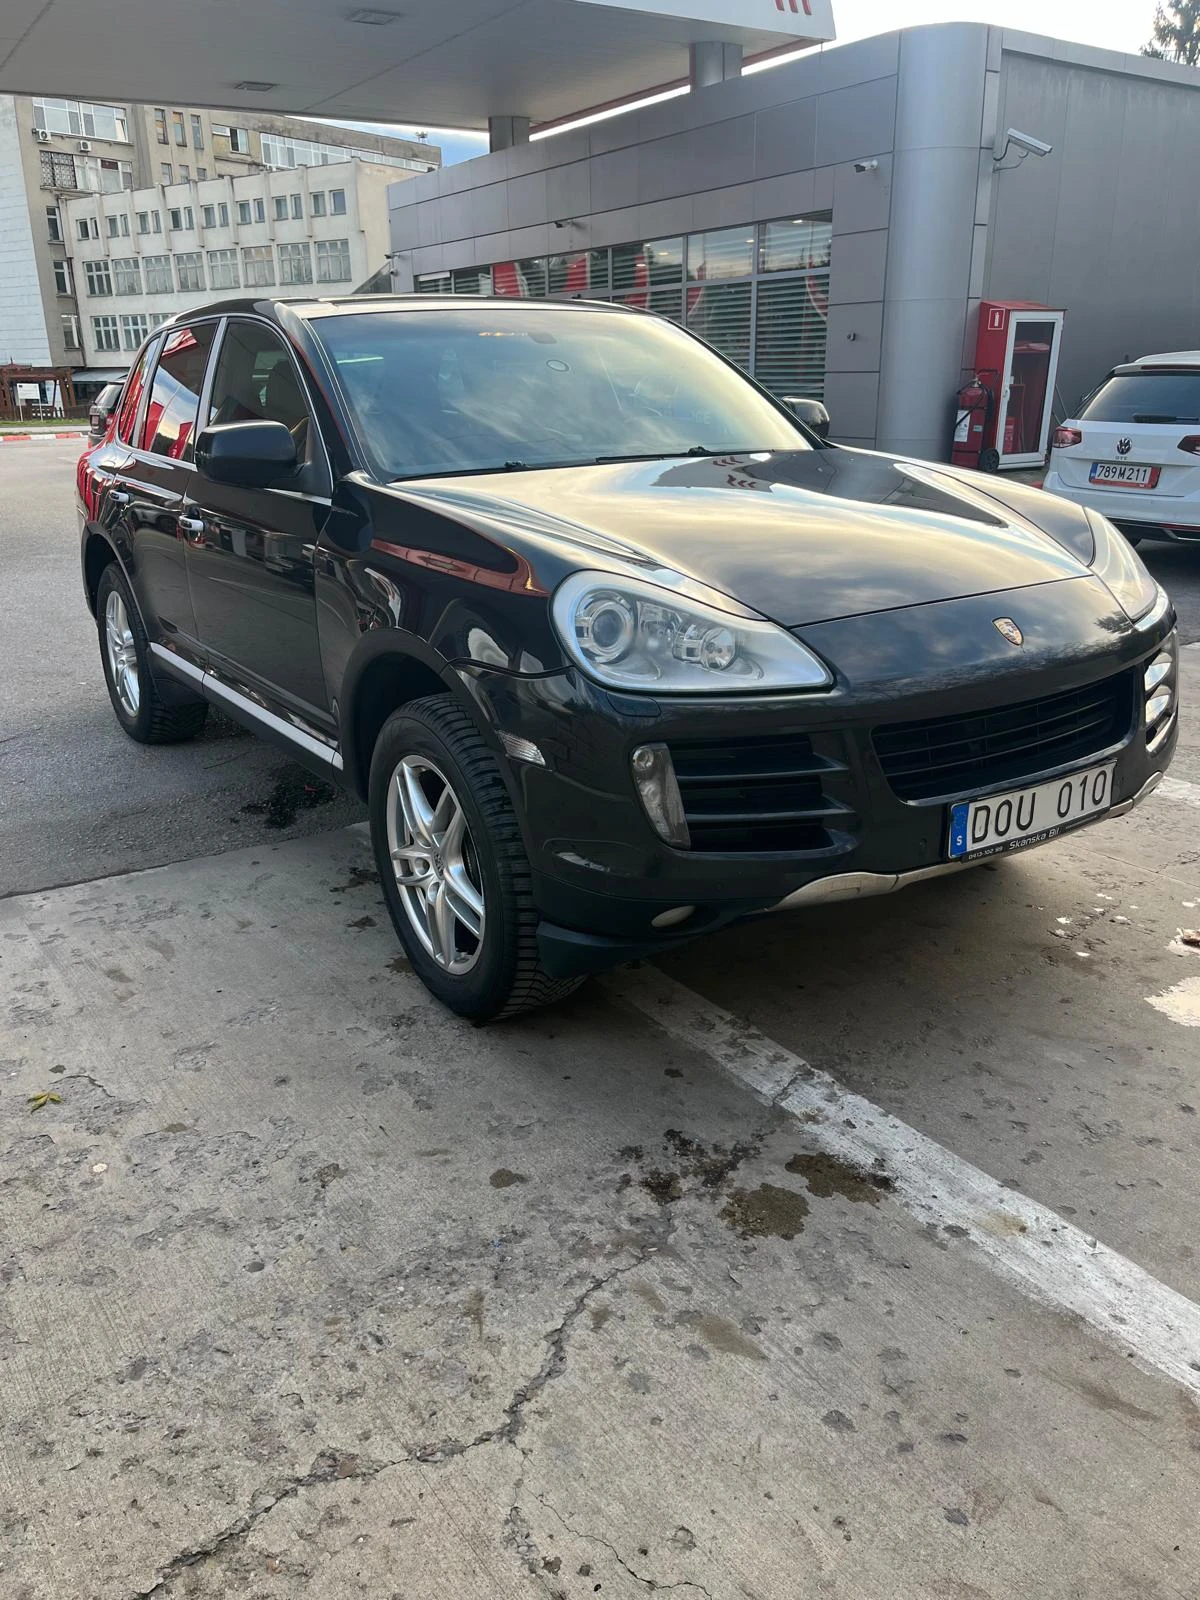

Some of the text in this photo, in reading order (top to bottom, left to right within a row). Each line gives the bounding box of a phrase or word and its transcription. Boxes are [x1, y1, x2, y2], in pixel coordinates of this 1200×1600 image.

[971, 769, 1107, 844] DOU 010
[956, 835, 963, 846] S
